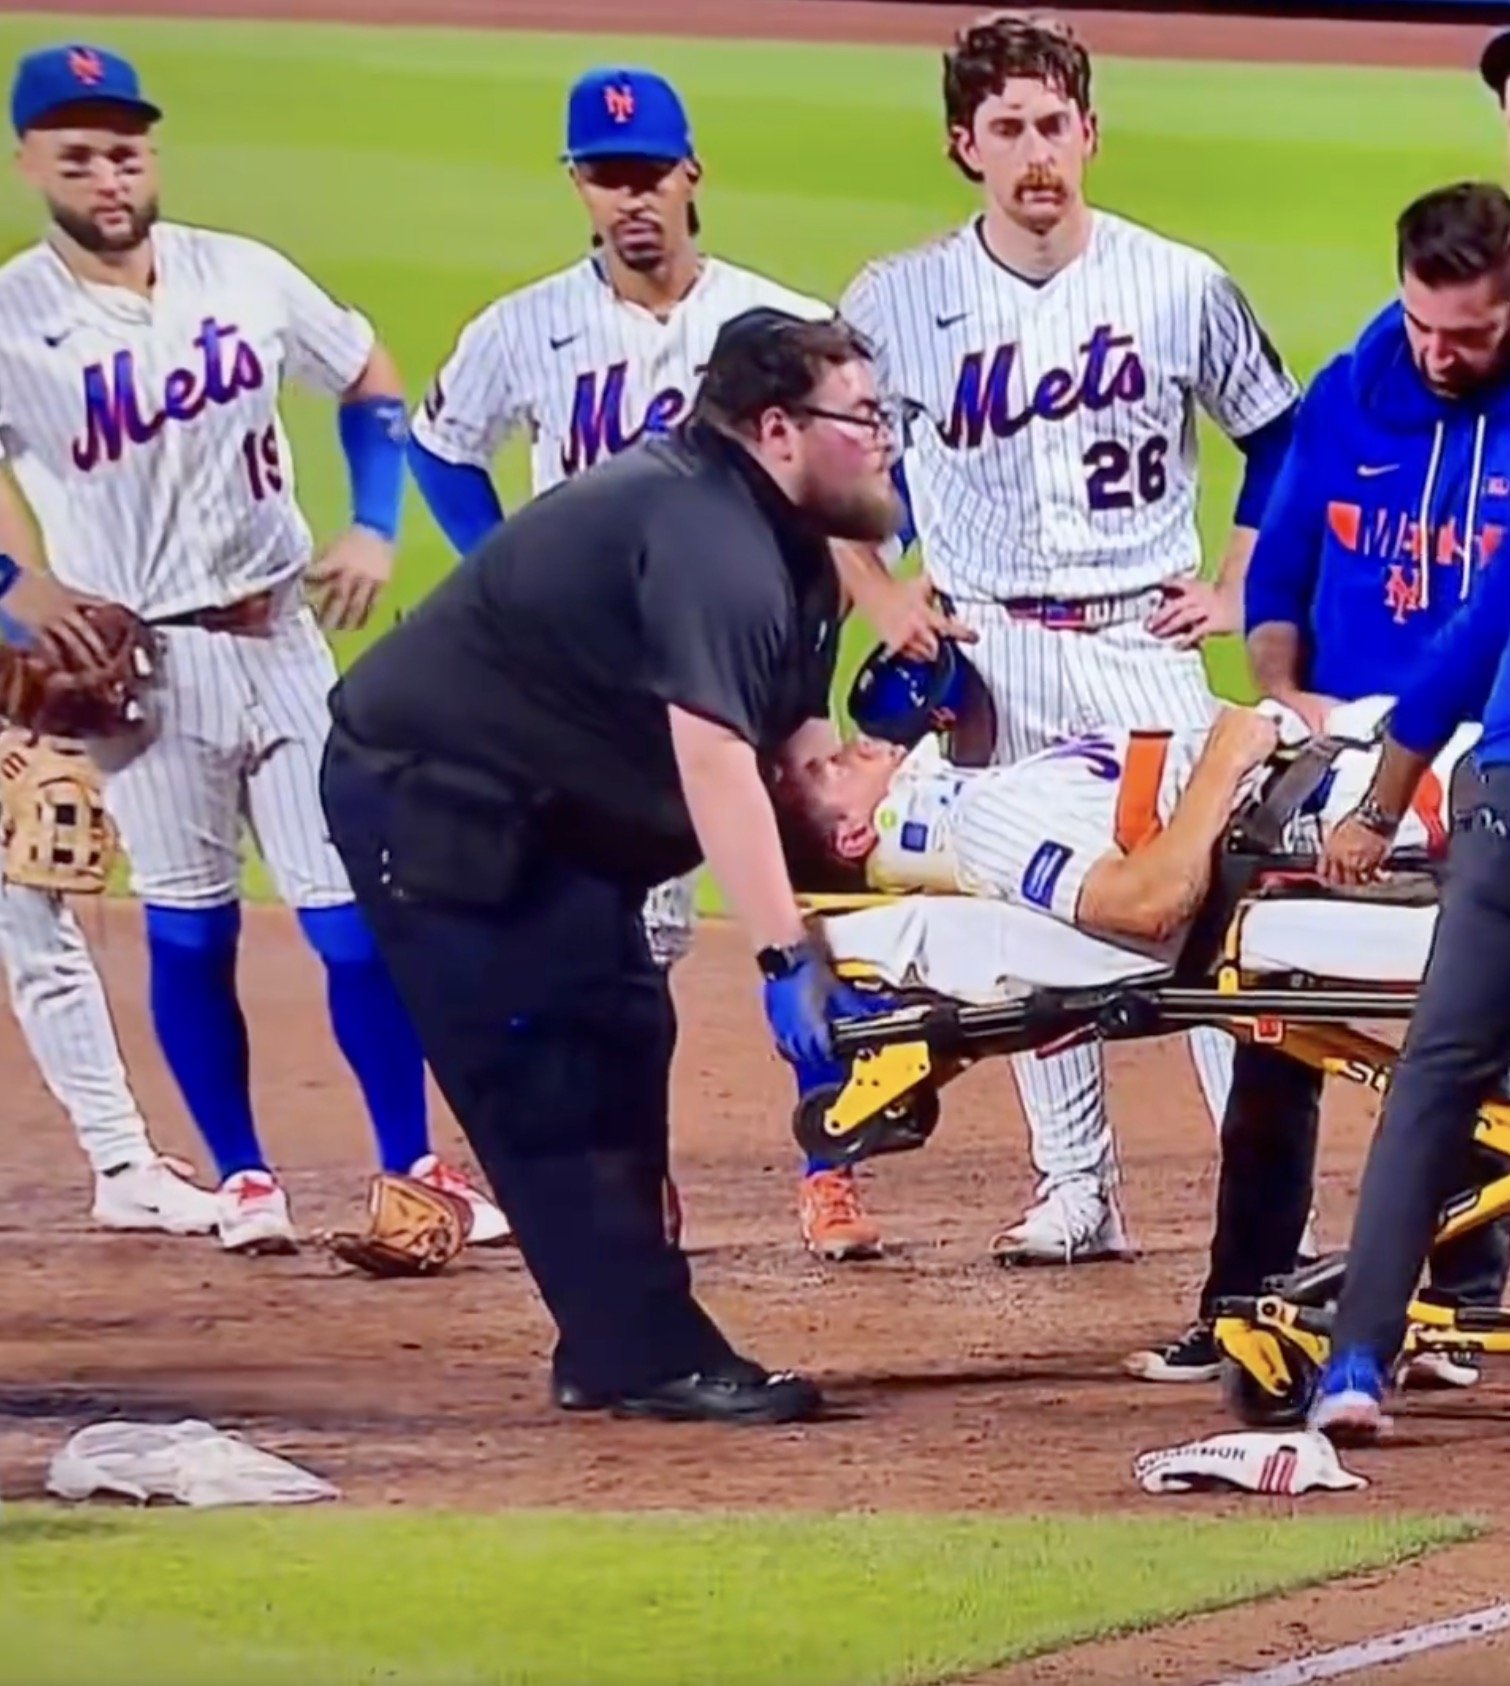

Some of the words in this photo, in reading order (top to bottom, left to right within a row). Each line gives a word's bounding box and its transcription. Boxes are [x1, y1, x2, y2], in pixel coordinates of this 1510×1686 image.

[73, 317, 263, 472] Mets
[561, 360, 709, 477] Me
[936, 325, 1146, 450] Mets
[1083, 435, 1168, 510] 26
